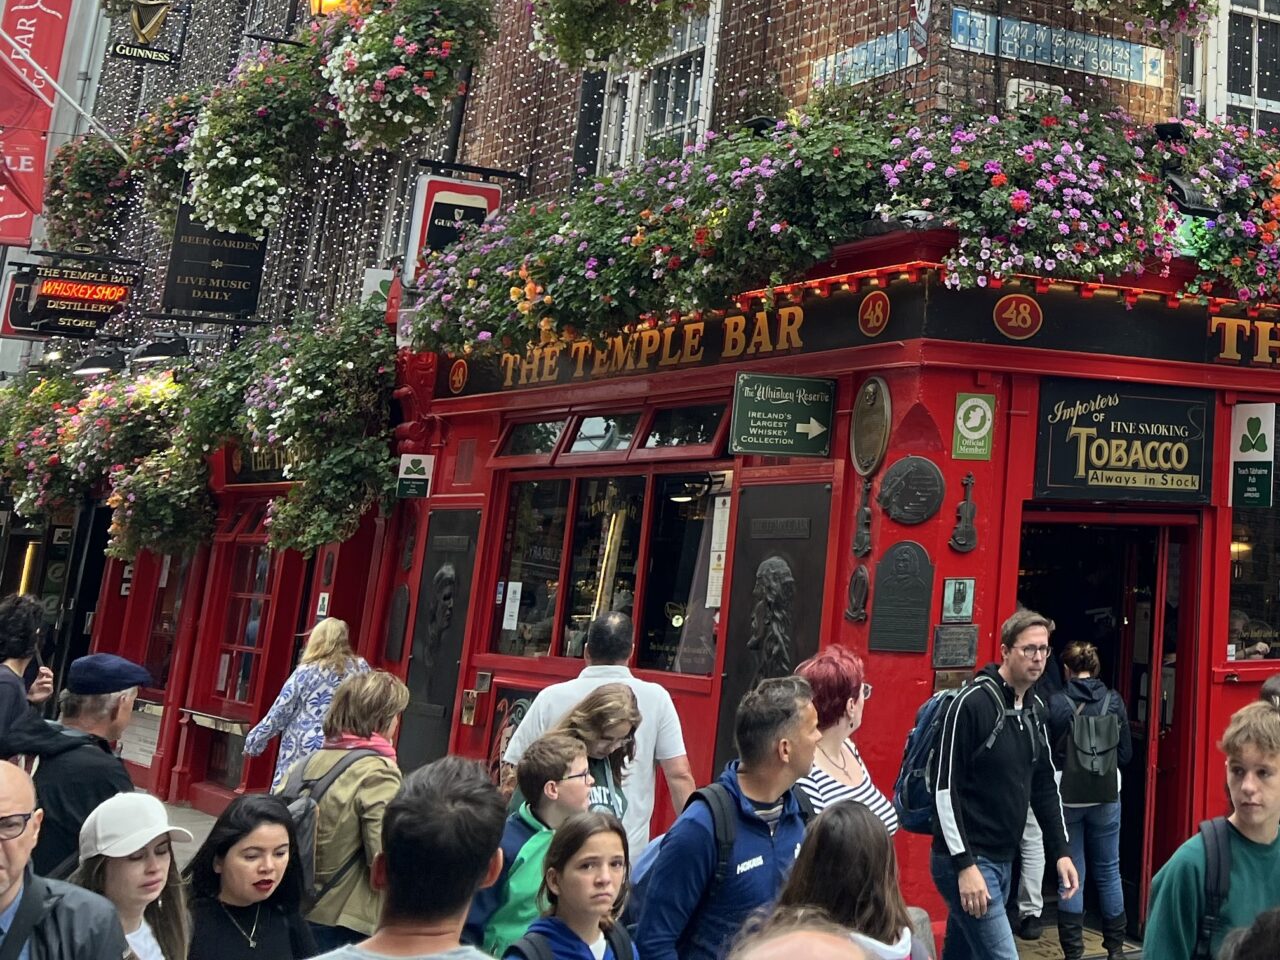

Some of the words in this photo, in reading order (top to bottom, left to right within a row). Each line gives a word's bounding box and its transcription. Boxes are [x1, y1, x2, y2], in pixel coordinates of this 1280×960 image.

[116, 44, 170, 62] GUINNESS
[1091, 58, 1134, 77] SOUTH
[180, 235, 211, 247] BEER
[212, 238, 260, 251] GARDEN
[37, 267, 60, 279] THE
[62, 269, 107, 283] TEMPLE
[110, 271, 134, 285] BAR
[176, 275, 207, 287] LIVE
[208, 278, 251, 290] MUSIC
[41, 280, 93, 300] WHISKEY
[93, 285, 126, 301] SHOP
[191, 289, 232, 301] DAILY
[47, 299, 115, 314] DISTILLERY
[58, 317, 97, 329] STORE
[1002, 300, 1032, 330] 48
[452, 366, 464, 388] 48
[501, 346, 560, 387] THE
[571, 320, 705, 378] TEMPLE
[721, 306, 804, 358] BAR
[864, 298, 884, 329] 48
[742, 386, 754, 397] The
[754, 382, 795, 404] Whiskey
[795, 387, 830, 406] Reserve
[748, 411, 792, 420] IRELAND'S
[1048, 393, 1120, 426] Importers
[1092, 412, 1105, 423] OF
[749, 427, 788, 436] WHISKEY
[750, 420, 788, 428] LARGEST
[1110, 421, 1137, 434] FINE
[1138, 423, 1190, 437] SMOKING
[740, 435, 794, 444] COLLECTION
[961, 439, 985, 447] Official
[960, 446, 986, 454] Member
[1066, 426, 1190, 479] TOBACCO
[1090, 470, 1137, 485] Always
[1144, 474, 1156, 485] in
[1160, 473, 1198, 488] Stock
